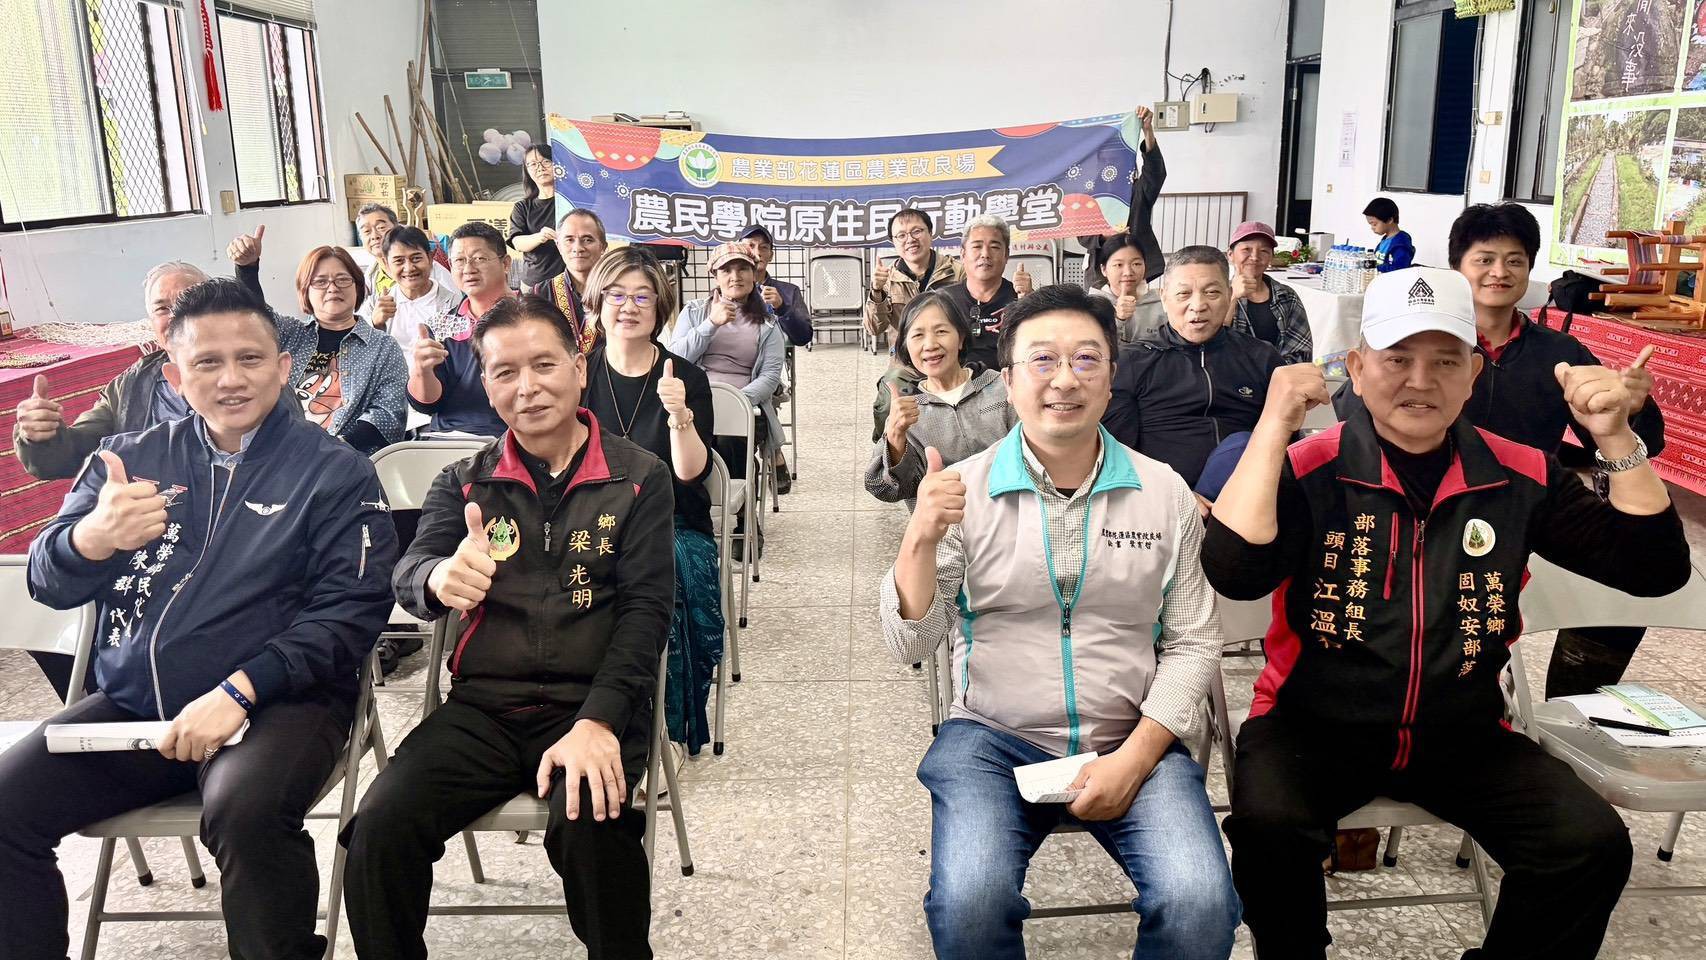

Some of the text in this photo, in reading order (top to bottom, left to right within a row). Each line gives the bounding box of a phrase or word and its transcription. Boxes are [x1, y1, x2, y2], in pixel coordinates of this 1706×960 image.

[731, 153, 976, 181] 農業部花蓮區農業改良場
[633, 187, 1059, 243] 農民學院原住民行動學堂
[595, 514, 616, 556] 鄉長
[568, 530, 593, 609] 梁光明
[1344, 513, 1376, 642] 部落事務組長
[1483, 571, 1506, 635] 萬榮鄉
